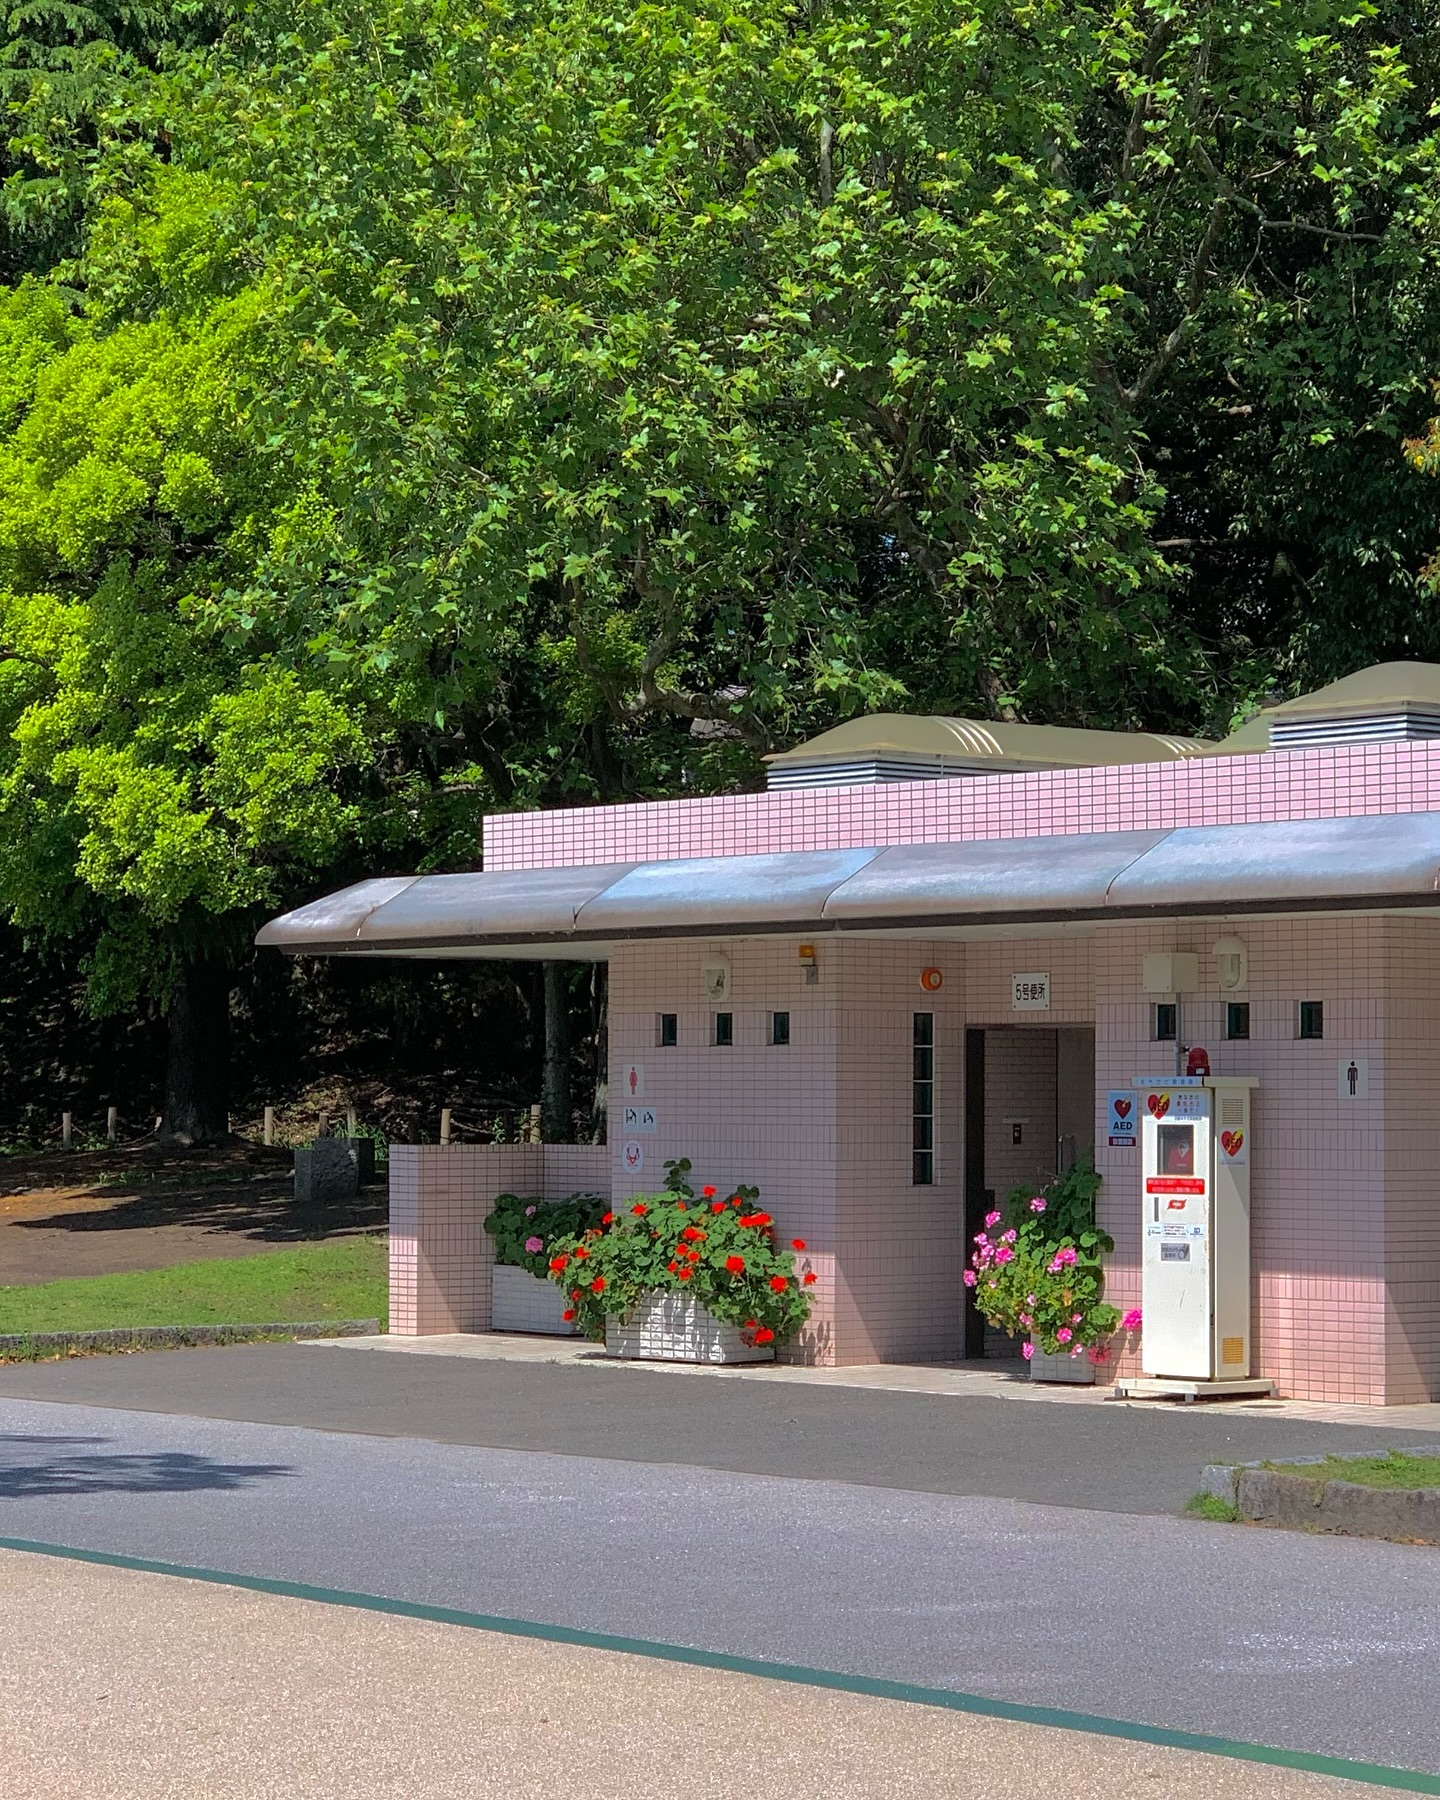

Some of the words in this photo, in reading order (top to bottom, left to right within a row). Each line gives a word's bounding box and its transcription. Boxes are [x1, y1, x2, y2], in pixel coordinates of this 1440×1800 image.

[1015, 983, 1045, 1000] 5号便所
[1152, 1101, 1169, 1112] AED
[1113, 1122, 1133, 1130] AED
[1226, 1137, 1242, 1148] AED
